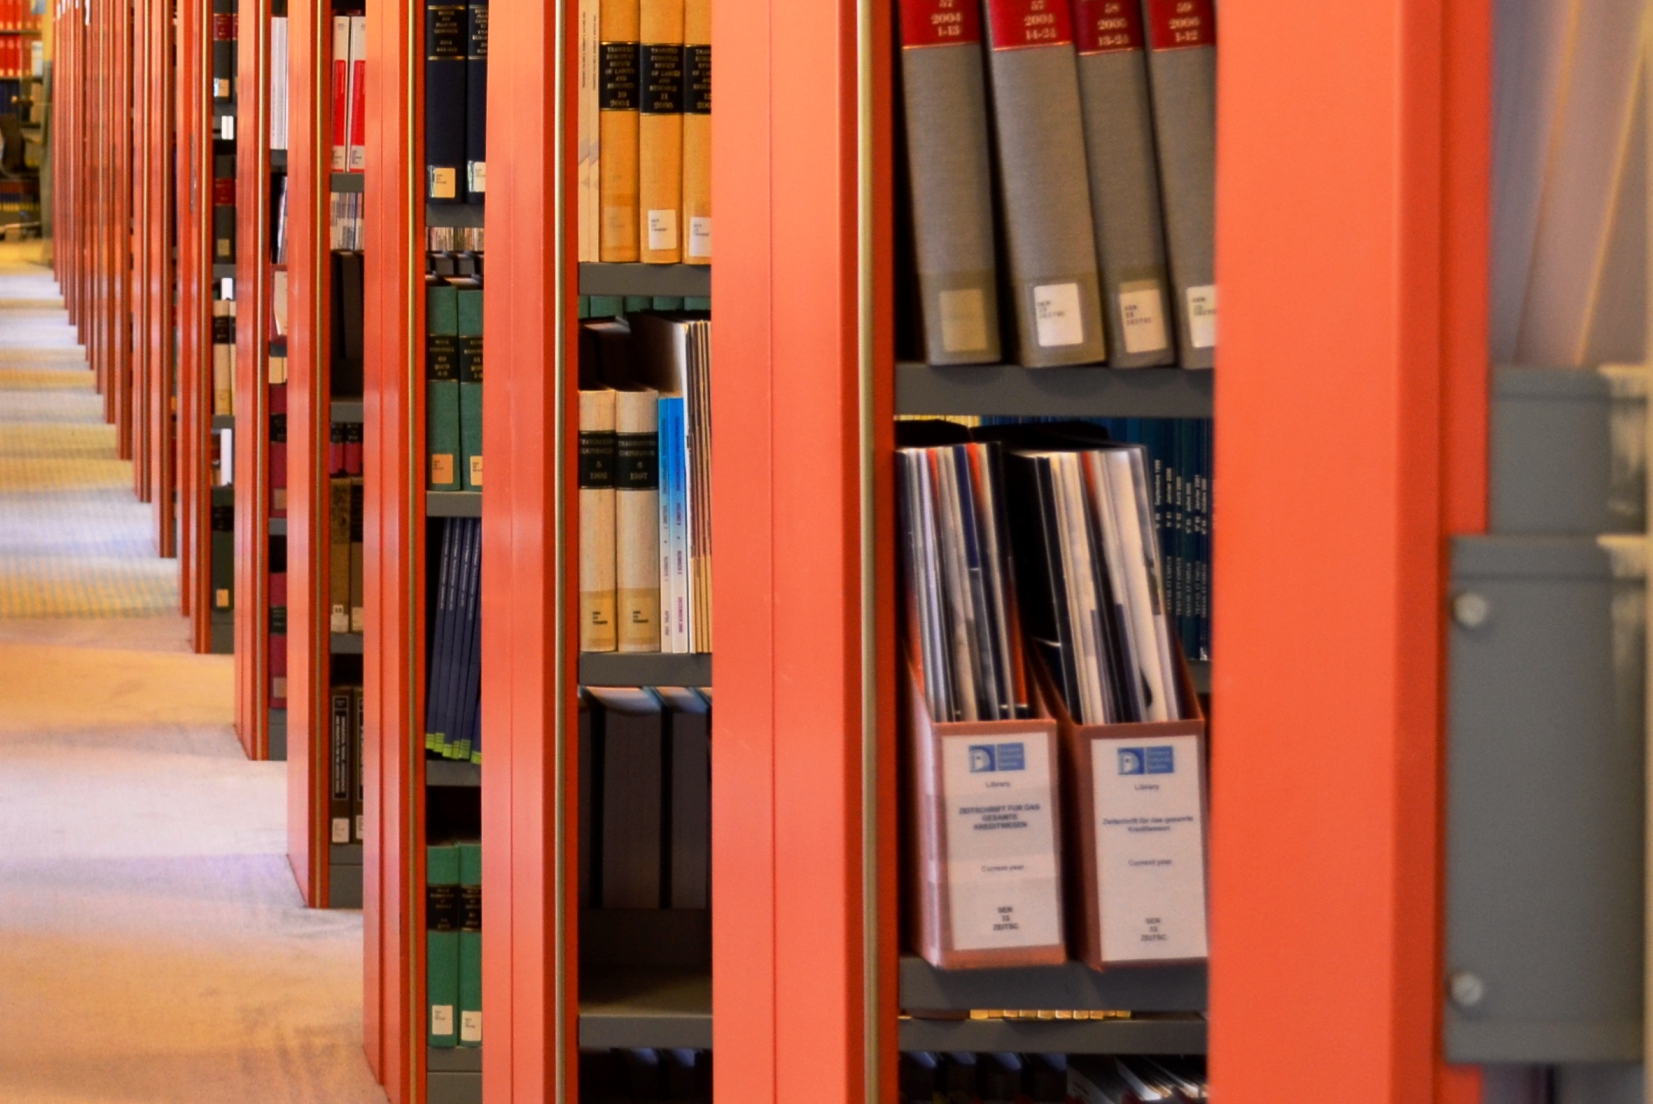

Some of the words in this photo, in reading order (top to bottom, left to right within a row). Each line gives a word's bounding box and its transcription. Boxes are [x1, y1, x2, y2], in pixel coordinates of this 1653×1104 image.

[1031, 0, 1044, 10] 57
[931, 12, 961, 24] 2004
[1024, 13, 1054, 26] 2004
[959, 806, 1005, 814] ZEITSCHRIFT
